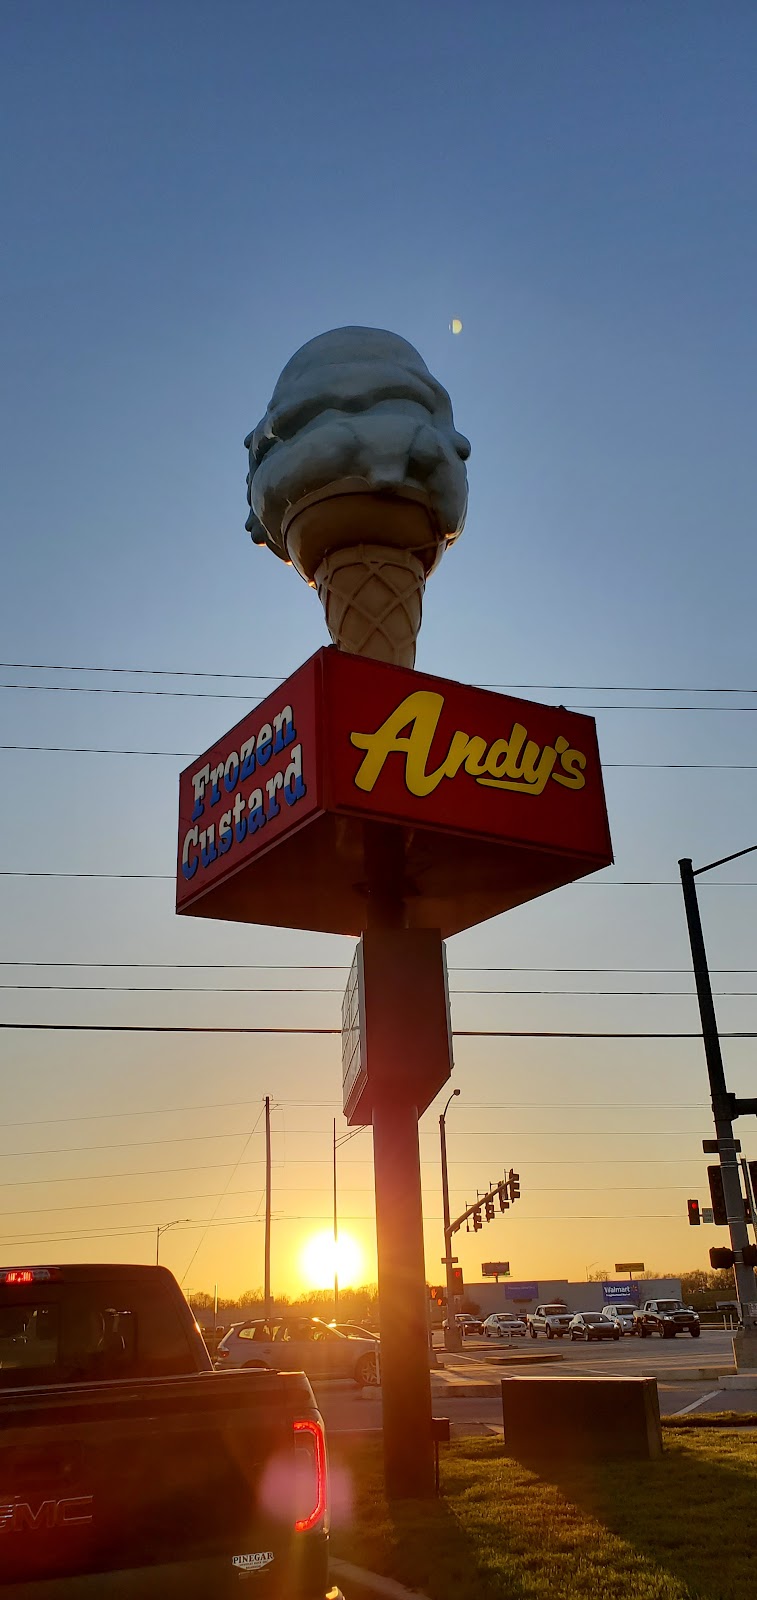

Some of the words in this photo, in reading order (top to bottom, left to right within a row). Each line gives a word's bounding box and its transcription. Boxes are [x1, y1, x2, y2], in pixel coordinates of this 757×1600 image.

[190, 703, 296, 822] Frozen
[350, 690, 587, 797] Andy's
[181, 743, 307, 881] Custard
[603, 1285, 631, 1293] Walmart
[233, 1552, 273, 1564] PINEGAR
